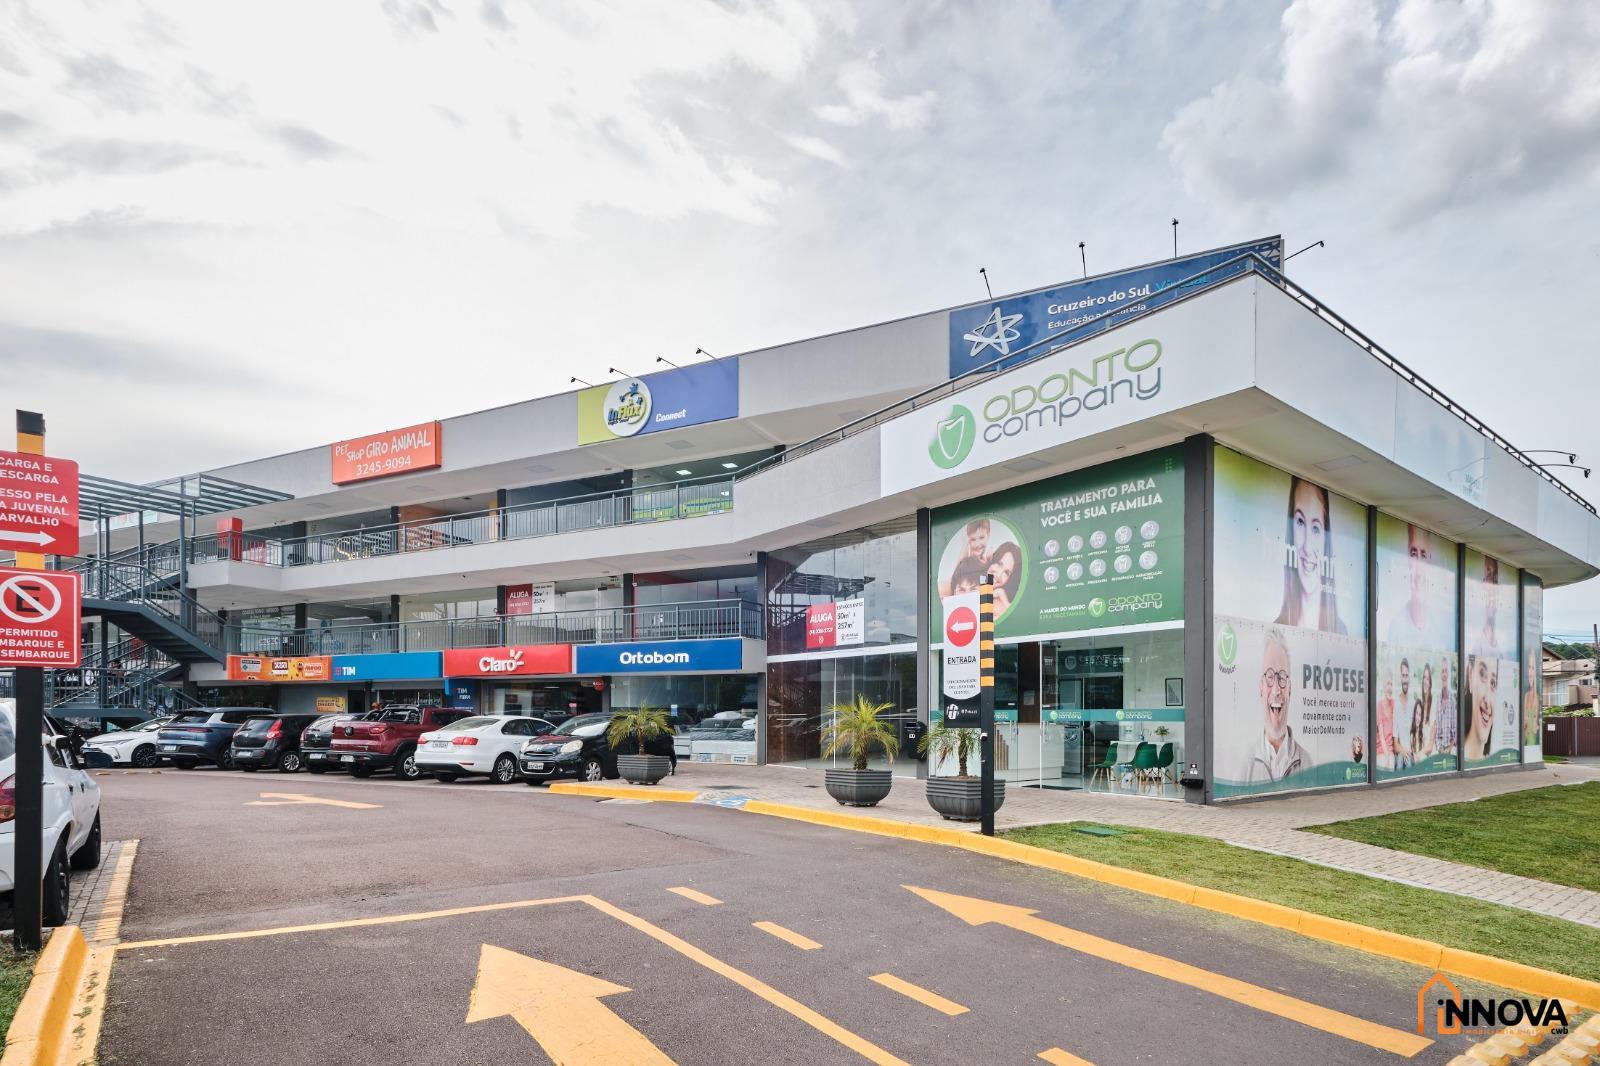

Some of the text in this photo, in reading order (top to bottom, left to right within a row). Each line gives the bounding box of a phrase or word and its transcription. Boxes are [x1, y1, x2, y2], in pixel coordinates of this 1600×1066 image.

[1047, 295, 1106, 315] Cruzeiro
[1108, 290, 1126, 303] do
[1128, 284, 1151, 299] Sul
[1048, 314, 1097, 329] Educação
[983, 338, 1163, 423] ODONTO
[983, 366, 1161, 443] company
[656, 409, 687, 422] Connect
[391, 429, 431, 454] ANIMAL
[335, 444, 348, 456] PET
[44, 463, 53, 472] E
[356, 455, 411, 476] 3245-9094
[35, 492, 69, 504] PELA
[1041, 477, 1156, 513] TRATAMENTO PARA
[11, 502, 70, 516] JUVENAL
[1041, 493, 1163, 528] VOCÊ E SUA FAMILIA
[510, 591, 529, 599] ALUGA
[1108, 592, 1162, 605] ODONTO
[1108, 601, 1163, 613] company
[810, 612, 833, 624] ALUGA
[1, 649, 71, 659] SEMBARQUE
[620, 652, 690, 664] Ortobom
[947, 656, 977, 664] ENTRADA
[479, 656, 516, 672] Claro
[342, 666, 356, 676] TIM
[1303, 659, 1365, 694] PRÓTESE
[1303, 697, 1355, 709] Você merece sorrir
[1303, 712, 1334, 721] novamente
